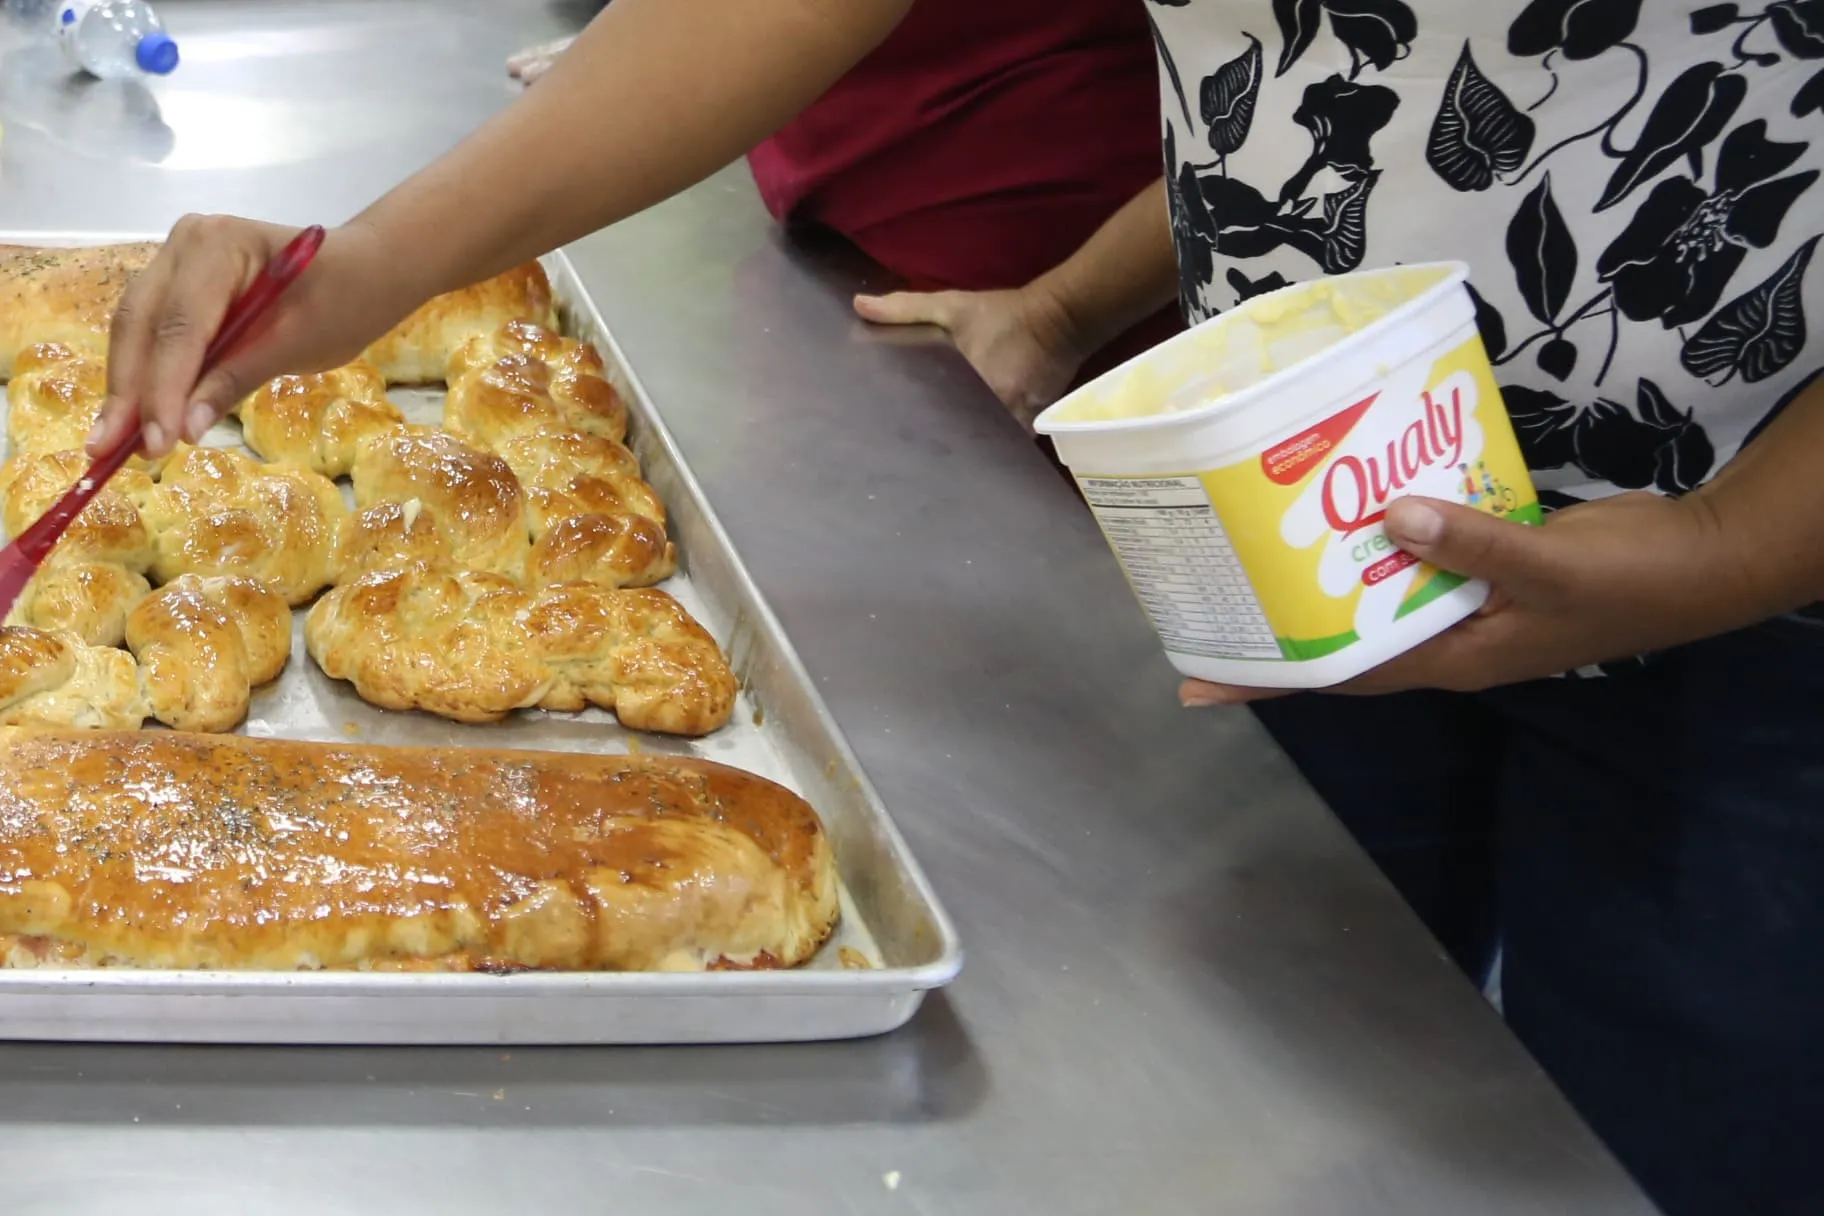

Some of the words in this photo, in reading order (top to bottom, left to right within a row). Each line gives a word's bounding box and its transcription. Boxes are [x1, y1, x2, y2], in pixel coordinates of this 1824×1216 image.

[1321, 387, 1463, 541] Qualy
[1351, 534, 1398, 563] cre
[1368, 557, 1399, 581] com
